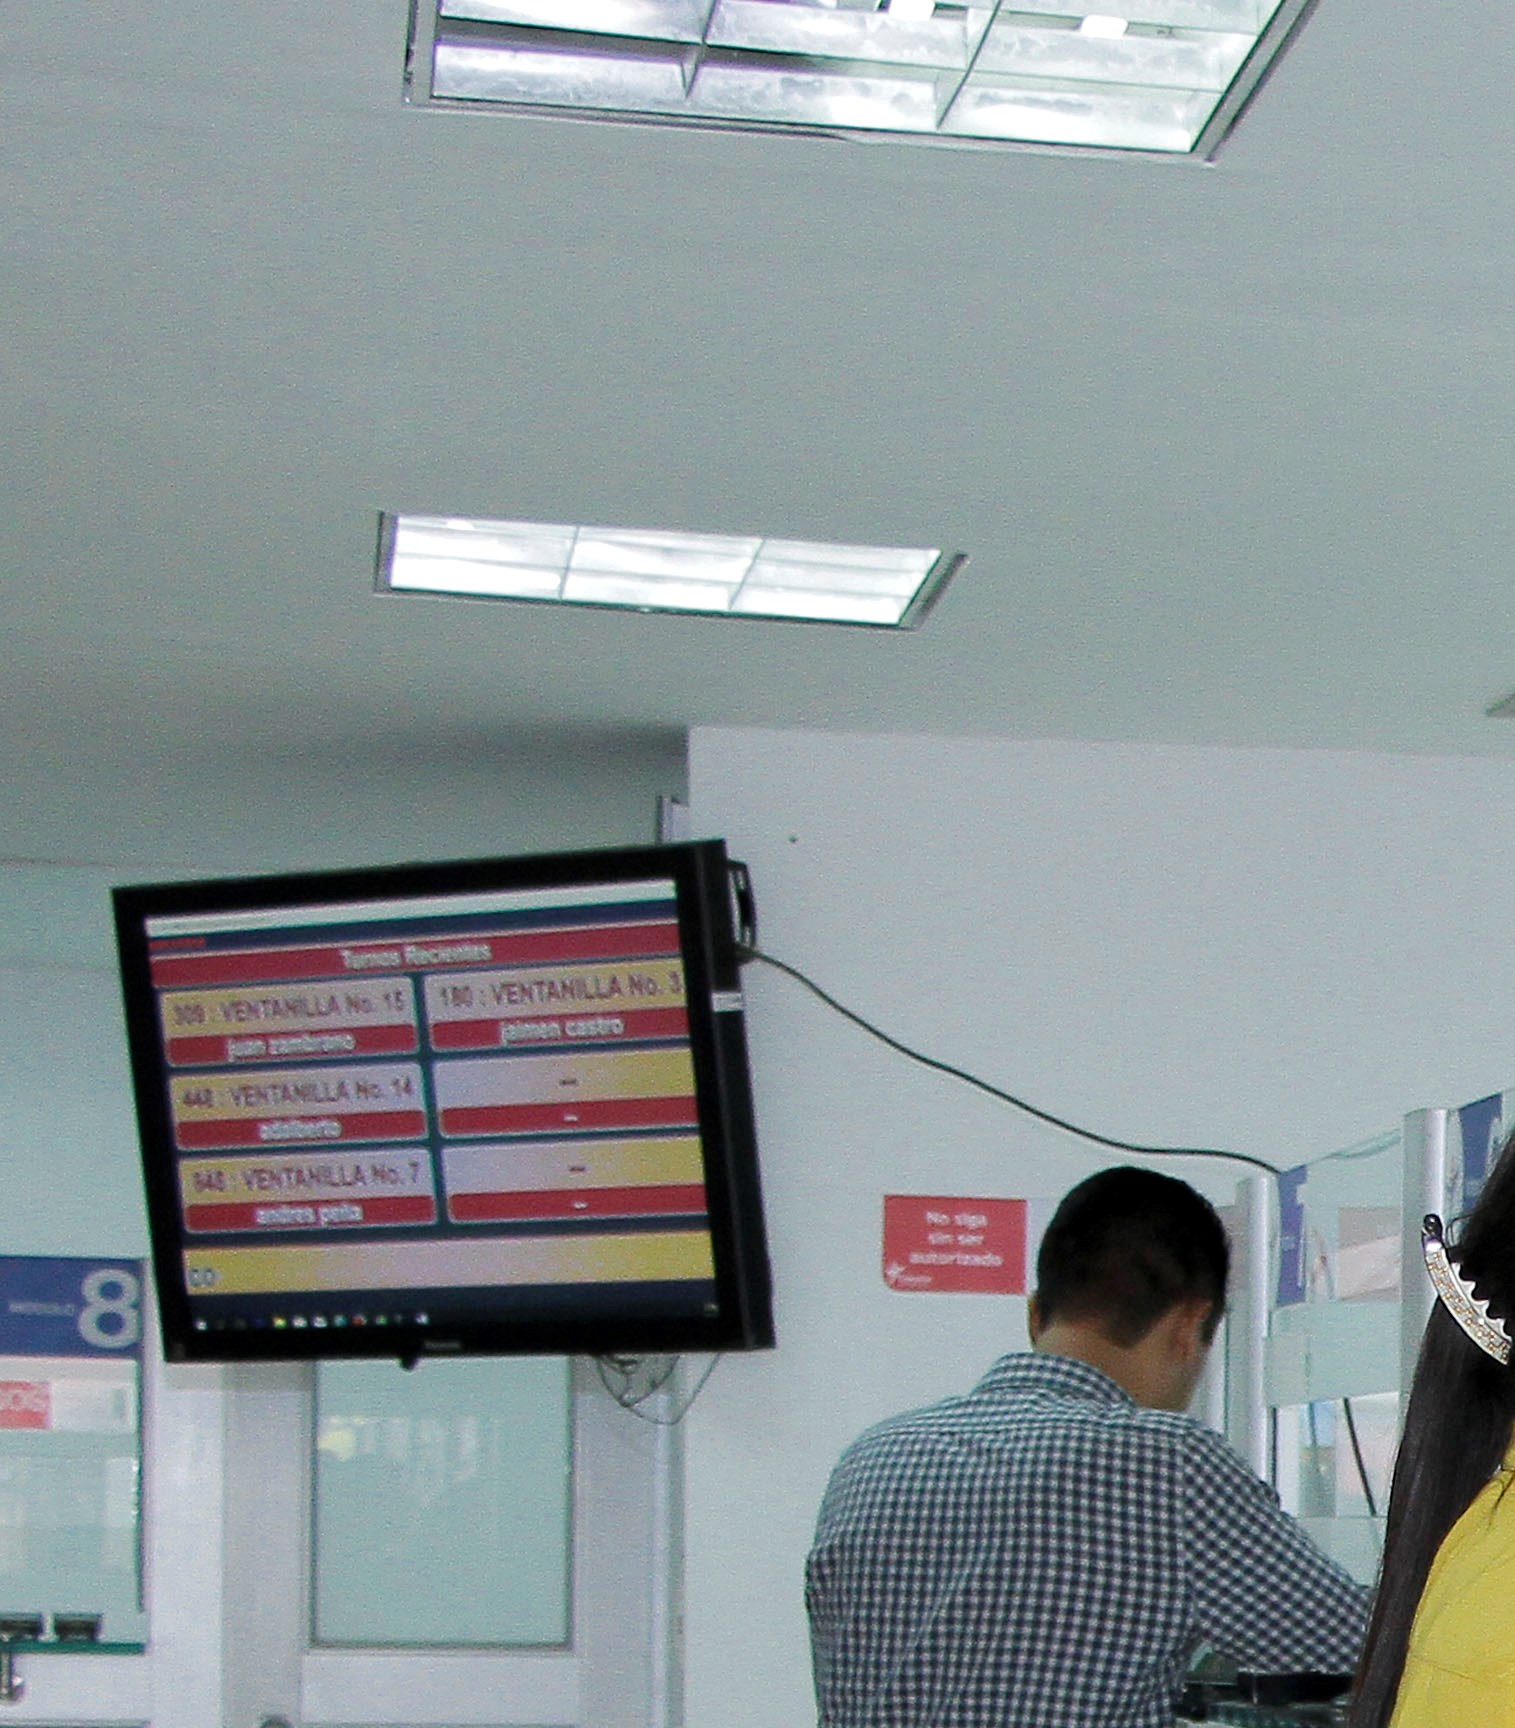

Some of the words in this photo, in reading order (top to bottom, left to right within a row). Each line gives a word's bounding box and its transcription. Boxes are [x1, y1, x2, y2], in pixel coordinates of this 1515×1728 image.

[492, 975, 622, 1005] VENTANILLA
[628, 971, 663, 995] No.
[219, 995, 341, 1023] VENTANILLA
[229, 1079, 349, 1107] VENTANILLA
[242, 1163, 366, 1191] VENTANILLA
[79, 1268, 142, 1349] 8
